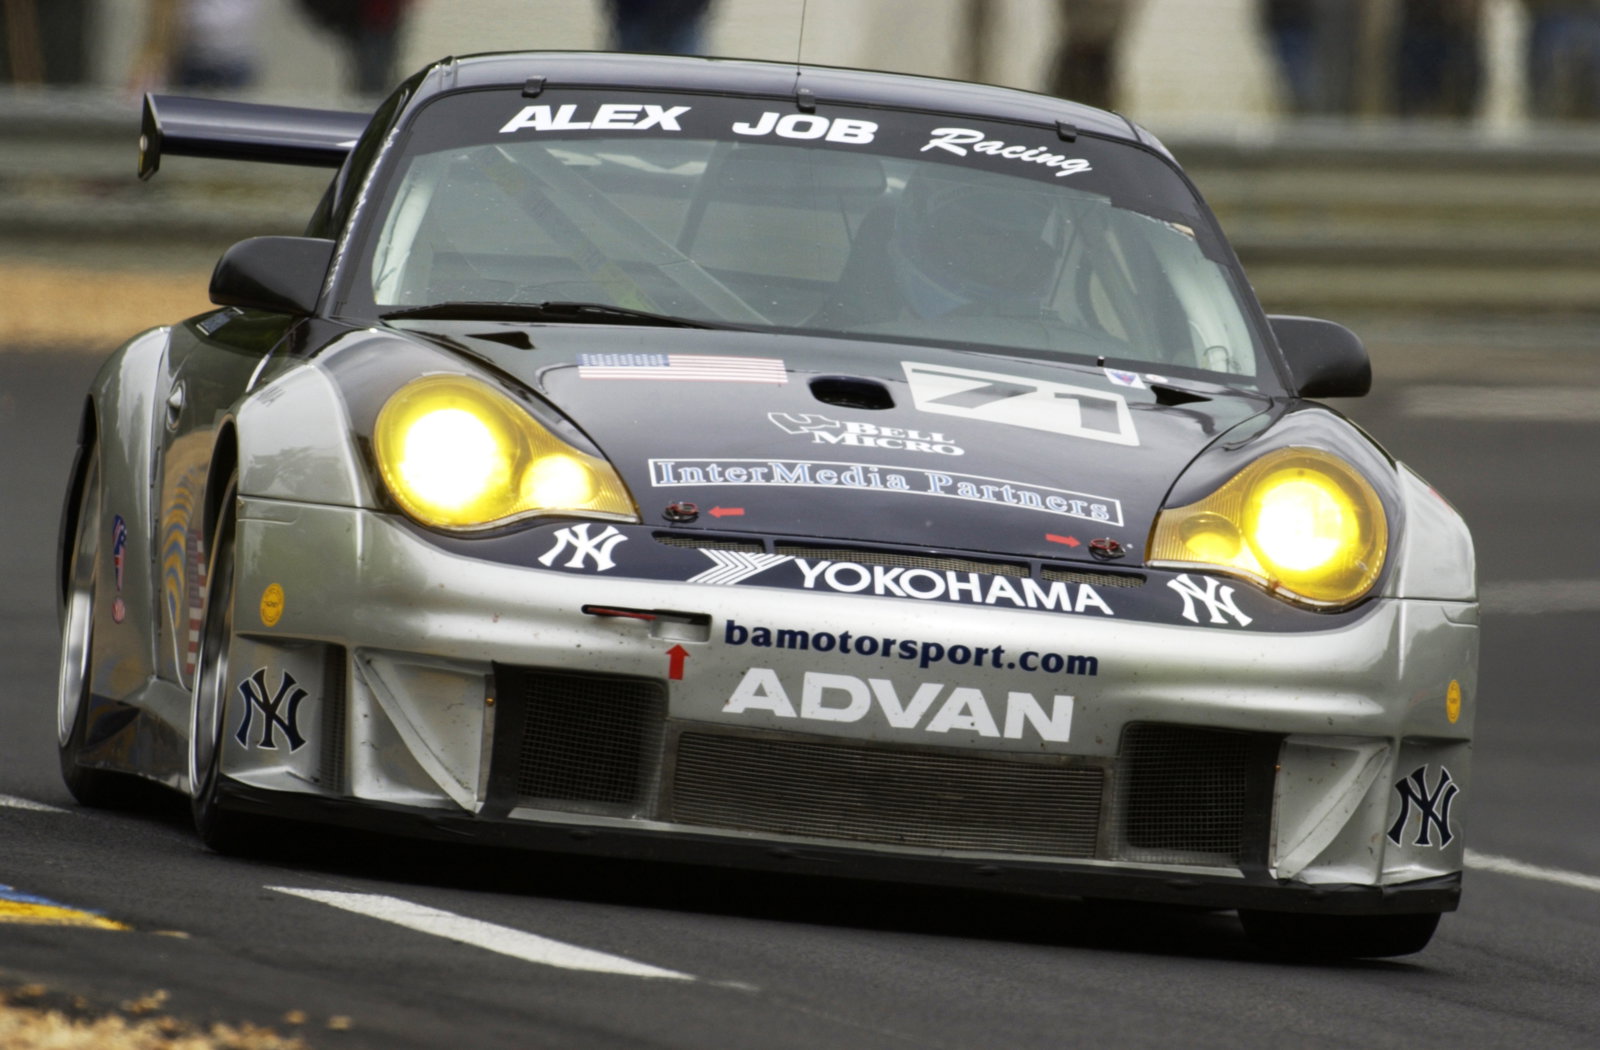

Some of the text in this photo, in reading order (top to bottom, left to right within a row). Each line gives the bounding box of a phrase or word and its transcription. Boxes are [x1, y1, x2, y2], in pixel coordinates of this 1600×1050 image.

[499, 104, 1093, 177] ALEX JOB Racing
[911, 367, 1123, 435] 71
[812, 430, 965, 456] MICRO
[845, 421, 955, 444] BELL
[657, 461, 1110, 521] InterMedia Partners
[795, 558, 1114, 615] YOKOHAMA
[725, 619, 1099, 676] bamotorsport.com
[721, 667, 1075, 743] ADVAN
